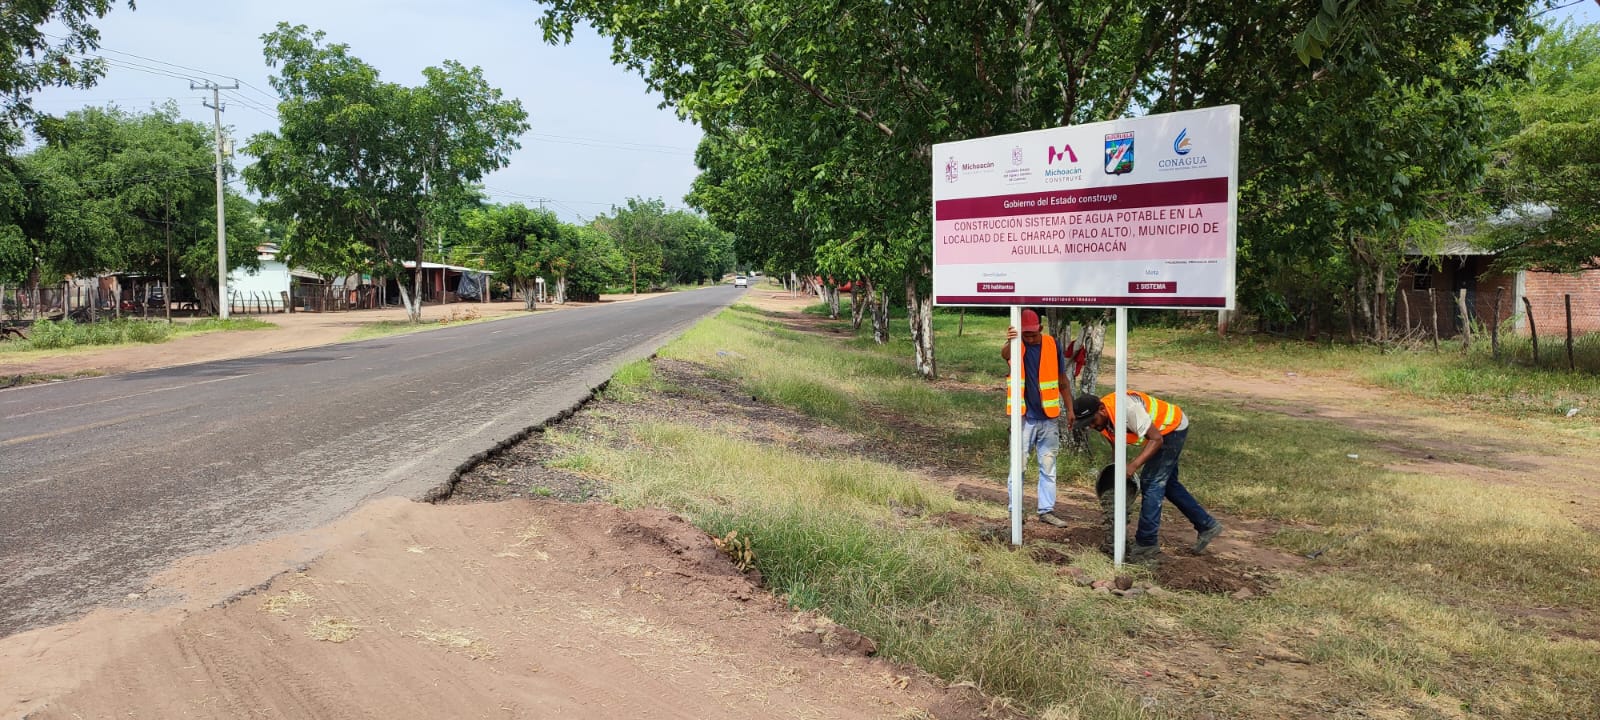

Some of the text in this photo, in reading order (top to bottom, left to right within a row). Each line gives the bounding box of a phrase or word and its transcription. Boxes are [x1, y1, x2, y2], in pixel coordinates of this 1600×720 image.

[1158, 156, 1207, 168] CONAGUA
[1045, 167, 1082, 176] Michoacán
[1004, 193, 1118, 208] Gobierno del Estado construye
[954, 208, 1203, 231] CONSTRUCCIÓN SISTEMA DE AGUA POTABLE EN LA
[944, 222, 1219, 244] LOCALIDAD DE EL CHARAPO (PALO ALTO), MUNICIPIO DE
[1011, 240, 1127, 255] AGUILILLA, MICHOACÁN
